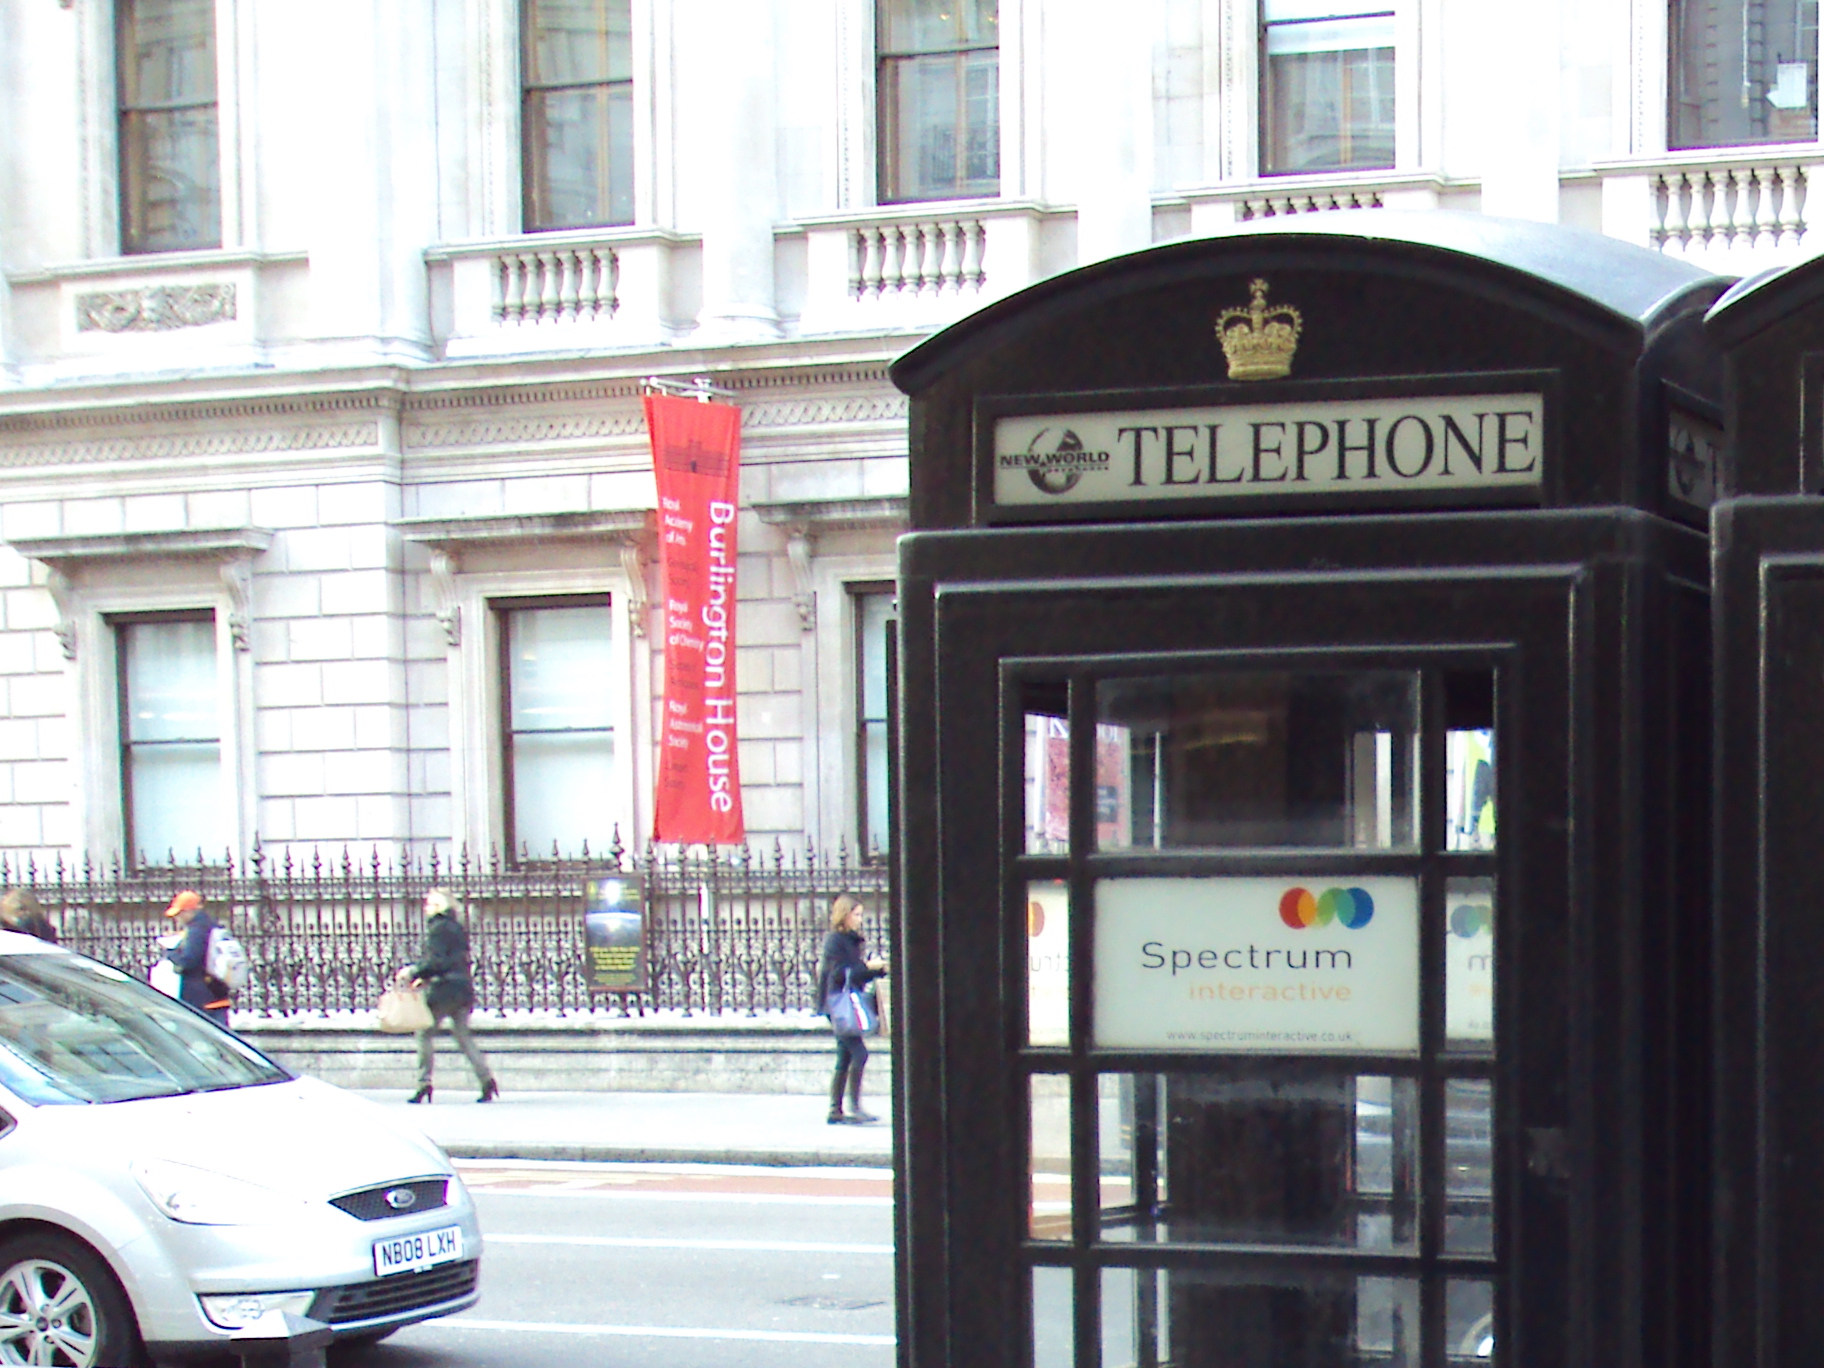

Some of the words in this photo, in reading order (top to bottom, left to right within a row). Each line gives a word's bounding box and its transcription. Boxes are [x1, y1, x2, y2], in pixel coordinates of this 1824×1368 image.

[1000, 453, 1040, 466] NEW
[1045, 451, 1110, 464] WORLD
[1116, 409, 1537, 486] TELEPHONE
[702, 501, 735, 687] Burlington
[704, 698, 735, 813] House
[1141, 939, 1353, 977] Spectrum
[1188, 981, 1353, 1003] interactive
[1166, 1029, 1354, 1043] www.spectruminteractive.co.uk
[382, 1237, 424, 1268] NB08
[426, 1230, 457, 1258] LXH
